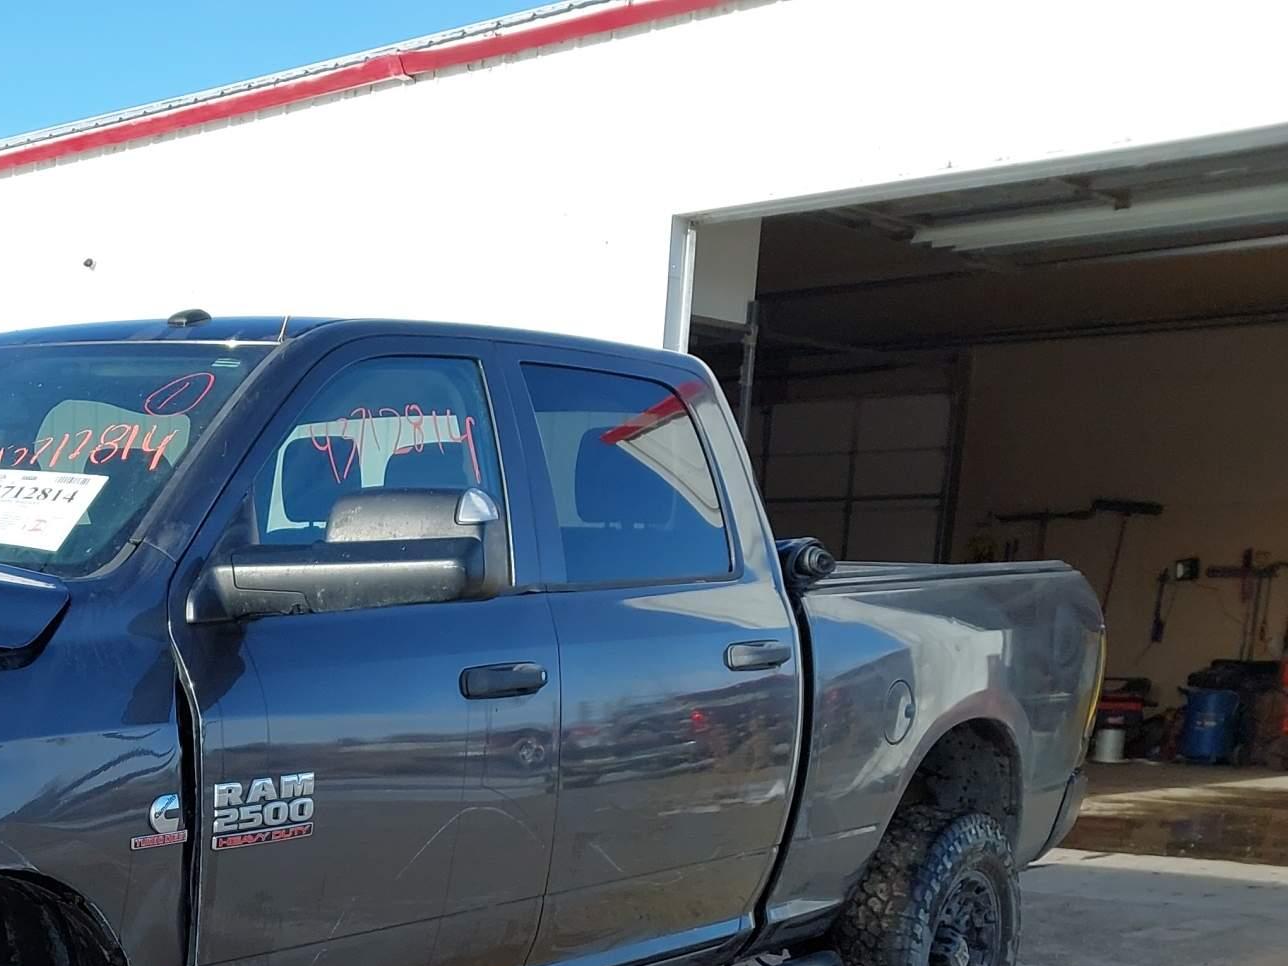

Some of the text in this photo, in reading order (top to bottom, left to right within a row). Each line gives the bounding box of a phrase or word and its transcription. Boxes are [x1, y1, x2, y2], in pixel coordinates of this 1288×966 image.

[214, 772, 315, 808] RAM
[214, 797, 314, 833] 2500
[218, 825, 311, 848] HEAVY DUTY
